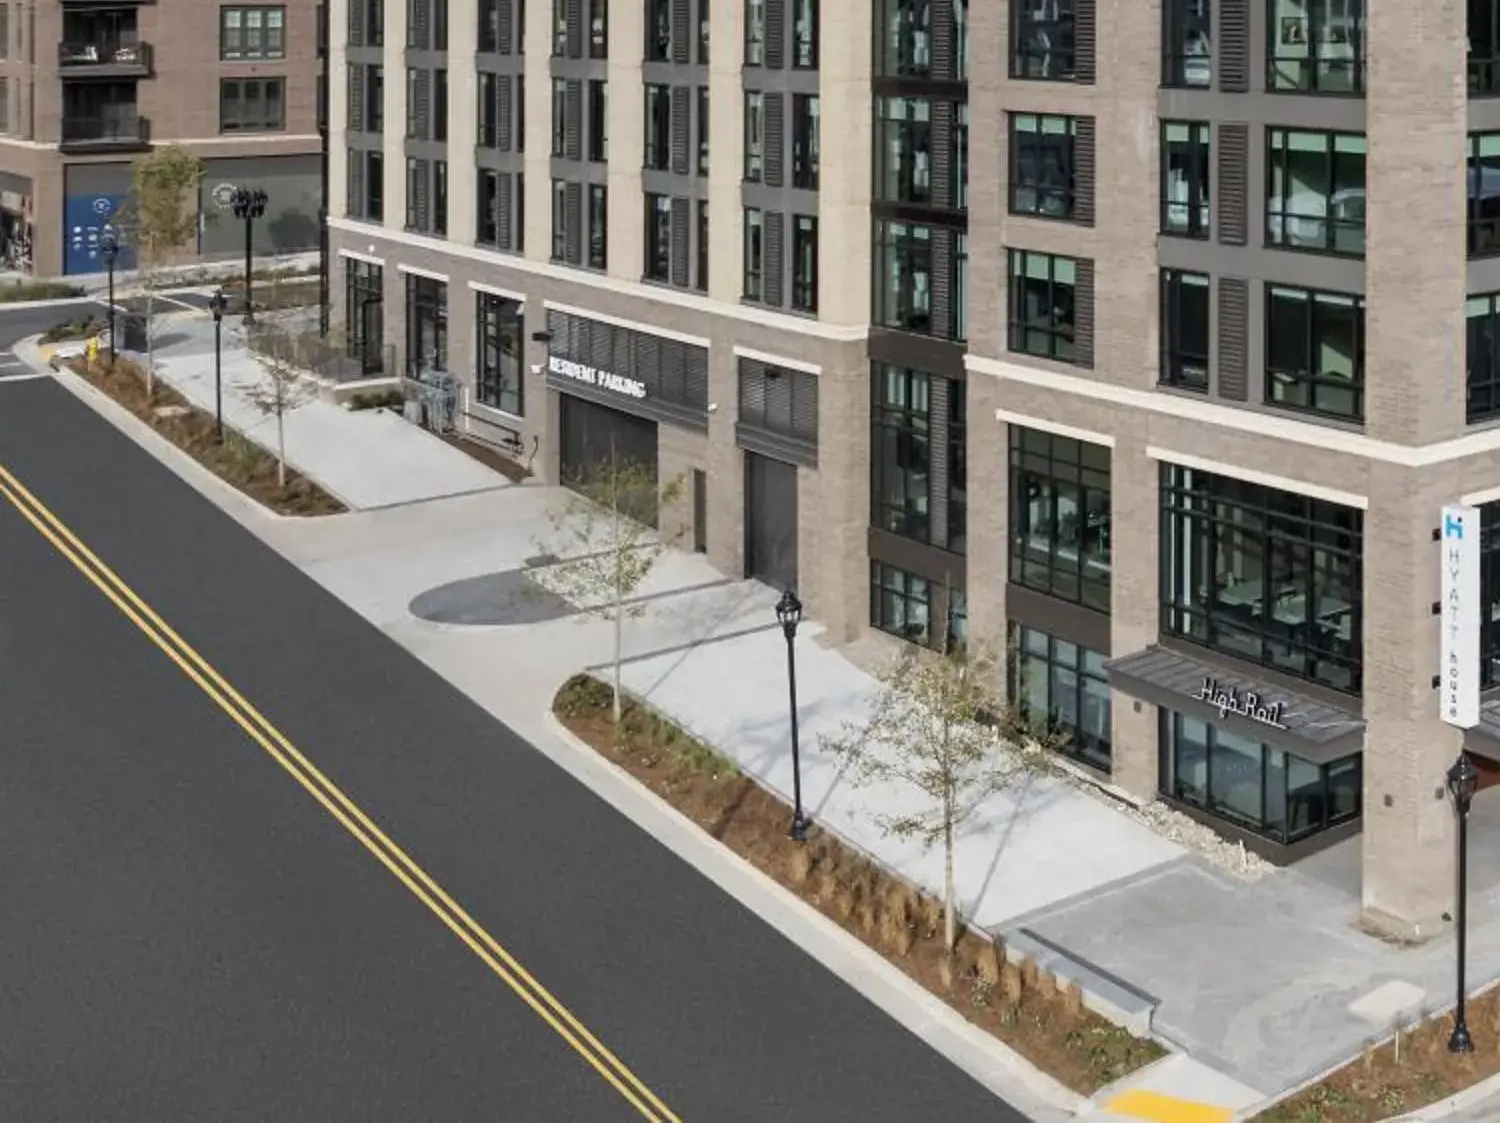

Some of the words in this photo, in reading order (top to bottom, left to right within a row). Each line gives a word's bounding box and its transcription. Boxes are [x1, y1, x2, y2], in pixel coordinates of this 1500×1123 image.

[1449, 547, 1460, 639] HYATT
[1192, 678, 1246, 718] High
[1245, 692, 1288, 730] Rail
